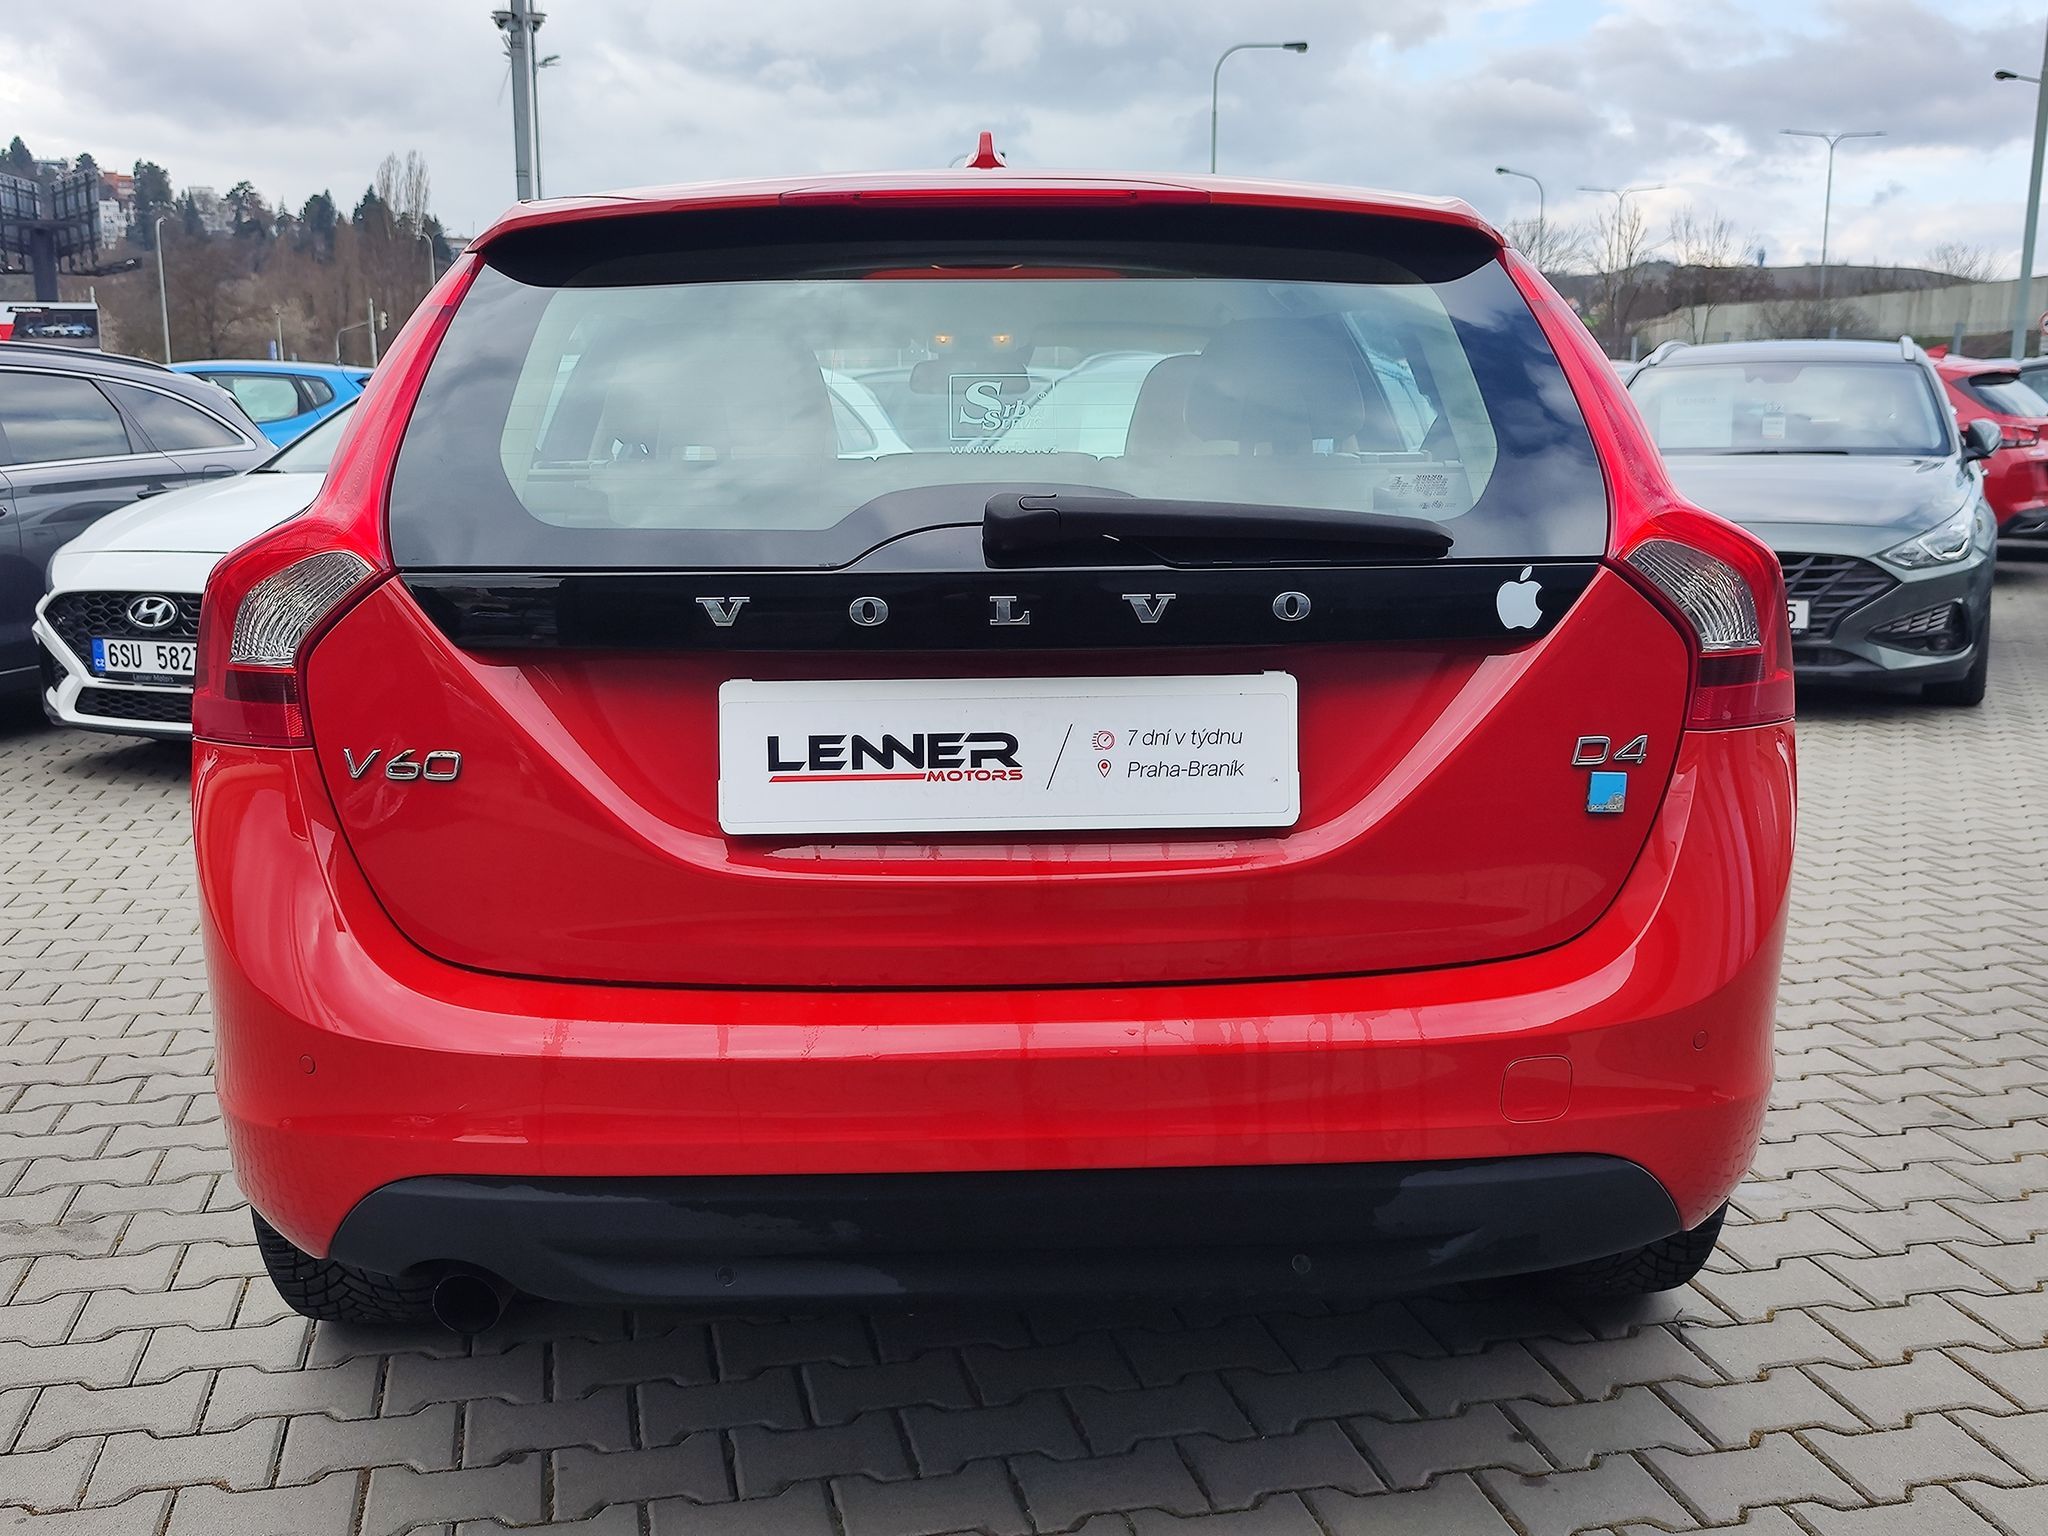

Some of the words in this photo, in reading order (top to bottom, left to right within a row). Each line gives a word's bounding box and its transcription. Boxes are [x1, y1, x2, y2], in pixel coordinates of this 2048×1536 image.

[696, 591, 1312, 627] VOLVO
[108, 643, 142, 668] 6SU
[156, 645, 197, 671] 582
[767, 732, 1022, 771] LENNER
[1128, 729, 1138, 746] 7
[1142, 729, 1171, 745] dní
[1175, 732, 1186, 745] v
[1191, 728, 1243, 749] týdnu
[1571, 734, 1648, 765] D4
[926, 770, 1023, 782] MOTORS
[1127, 759, 1245, 777] Praha-Braník
